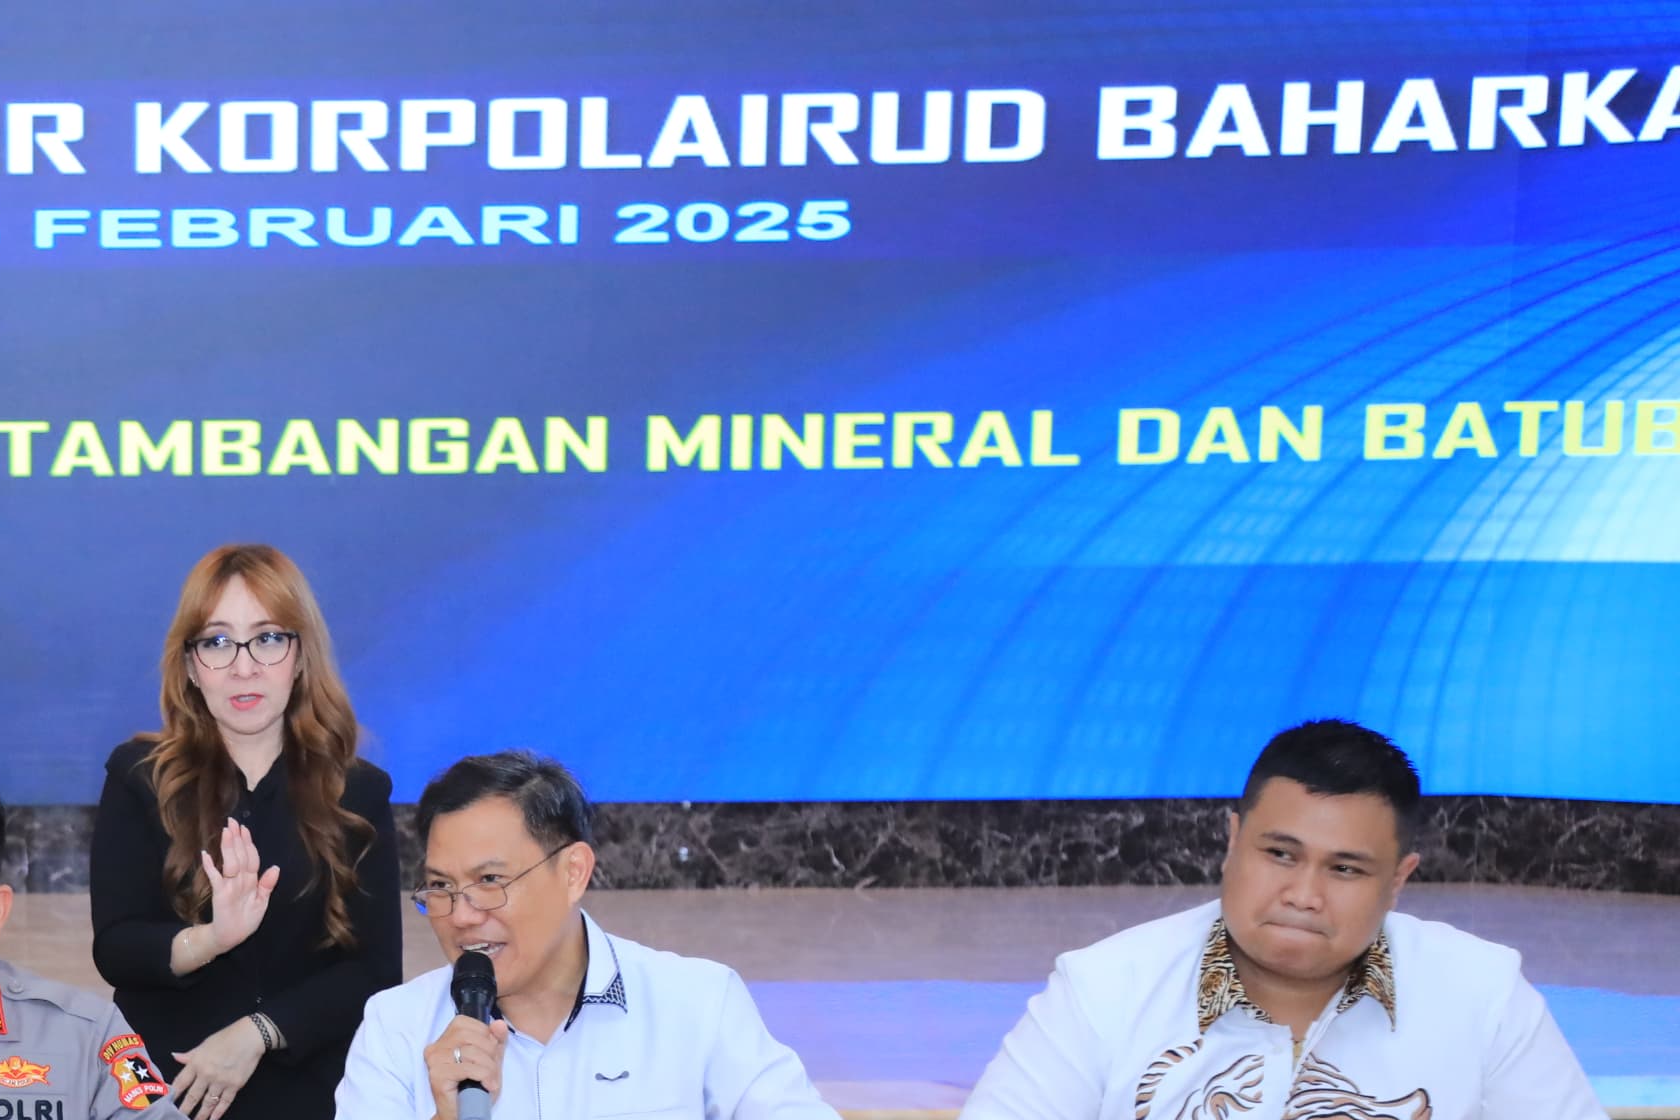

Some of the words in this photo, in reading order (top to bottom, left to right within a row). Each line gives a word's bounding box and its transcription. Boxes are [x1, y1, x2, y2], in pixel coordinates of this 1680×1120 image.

[135, 90, 1046, 174] KORPOLAIRUD
[34, 204, 578, 248] FEBRUARI
[615, 201, 851, 243] 2025
[646, 410, 1079, 471] MINERAL
[1117, 404, 1324, 465] DAN
[1363, 400, 1680, 462] BATUB
